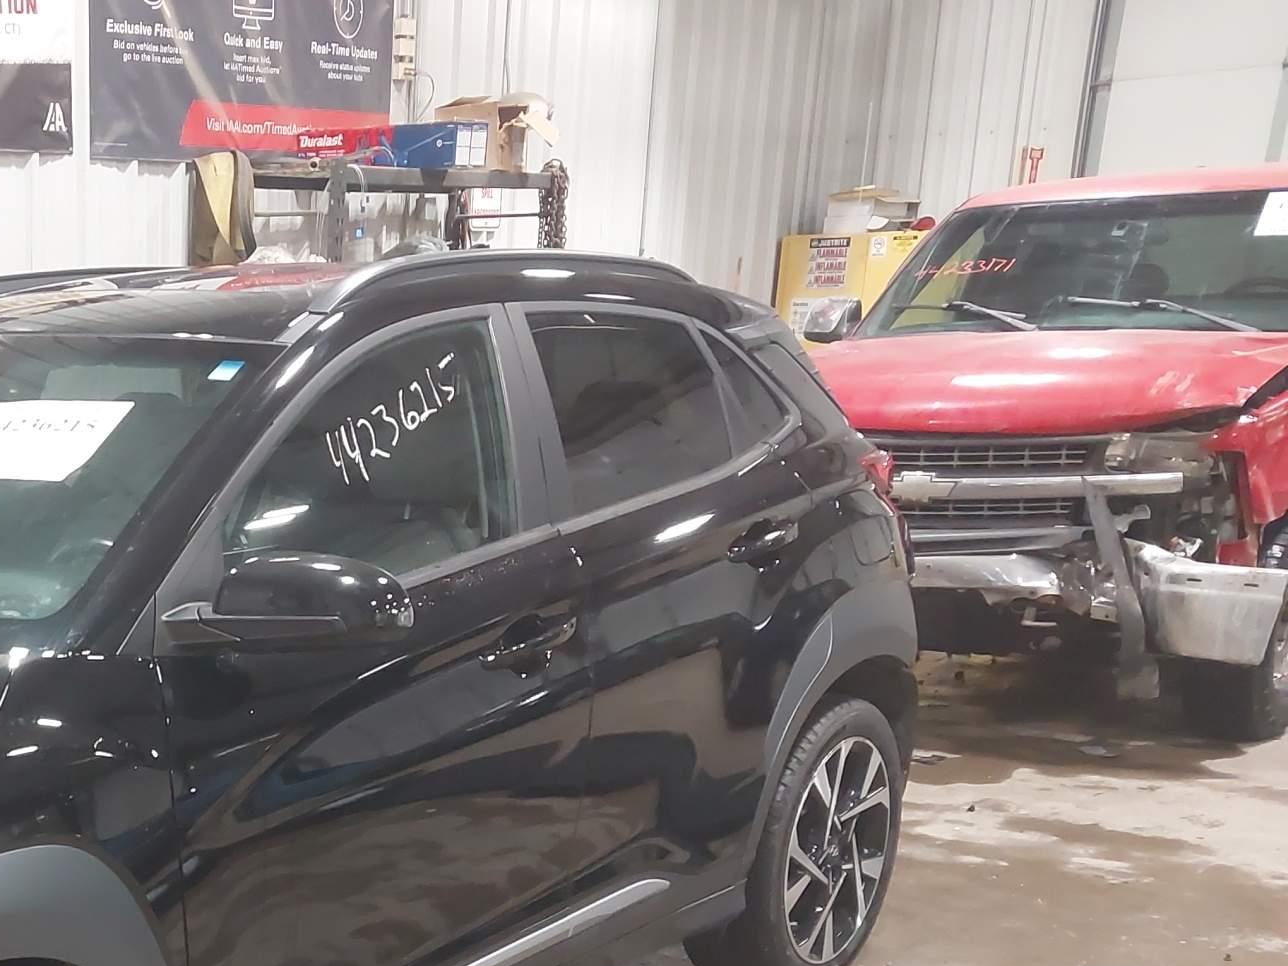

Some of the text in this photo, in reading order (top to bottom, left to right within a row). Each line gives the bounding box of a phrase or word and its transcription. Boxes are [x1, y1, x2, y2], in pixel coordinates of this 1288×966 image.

[106, 18, 153, 36] Exclusive
[113, 39, 125, 49] Bid
[126, 42, 135, 50] on
[136, 42, 159, 53] vehicles
[223, 32, 284, 53] Quick and Easy
[311, 41, 378, 60] Real-Time Updates
[123, 52, 132, 62] go
[133, 52, 140, 61] to
[141, 53, 151, 63] the
[162, 56, 184, 65] auction
[206, 116, 225, 131] Visit
[298, 133, 344, 148] Duralast
[325, 352, 455, 485] 44236215
